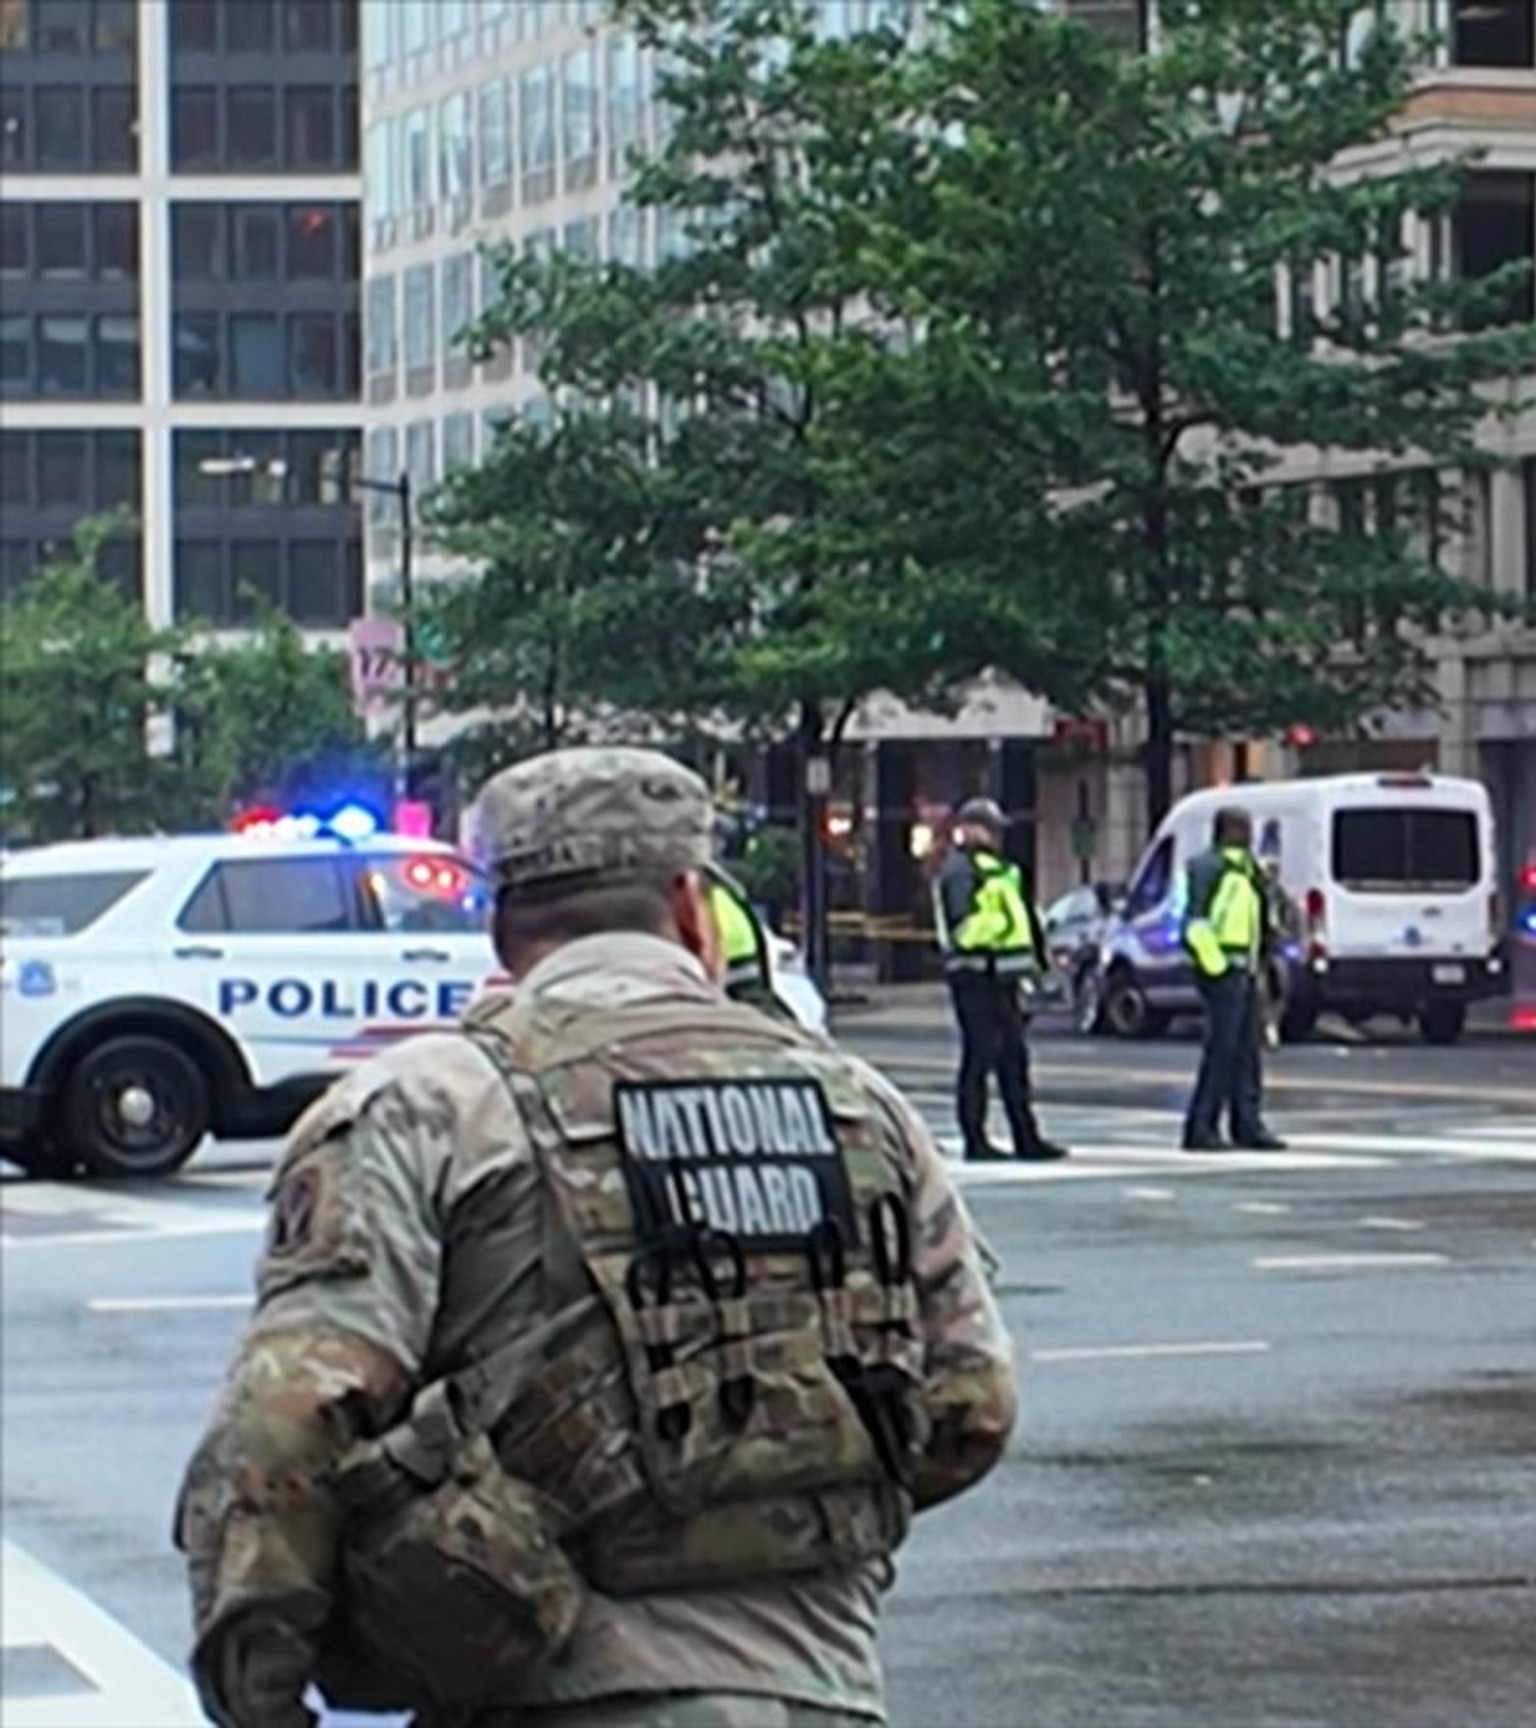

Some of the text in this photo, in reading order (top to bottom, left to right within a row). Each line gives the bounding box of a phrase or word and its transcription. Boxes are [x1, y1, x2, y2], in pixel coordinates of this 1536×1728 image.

[218, 979, 474, 1019] POLICE
[618, 1086, 836, 1160] NATIONAL
[665, 1163, 823, 1238] GUARD
